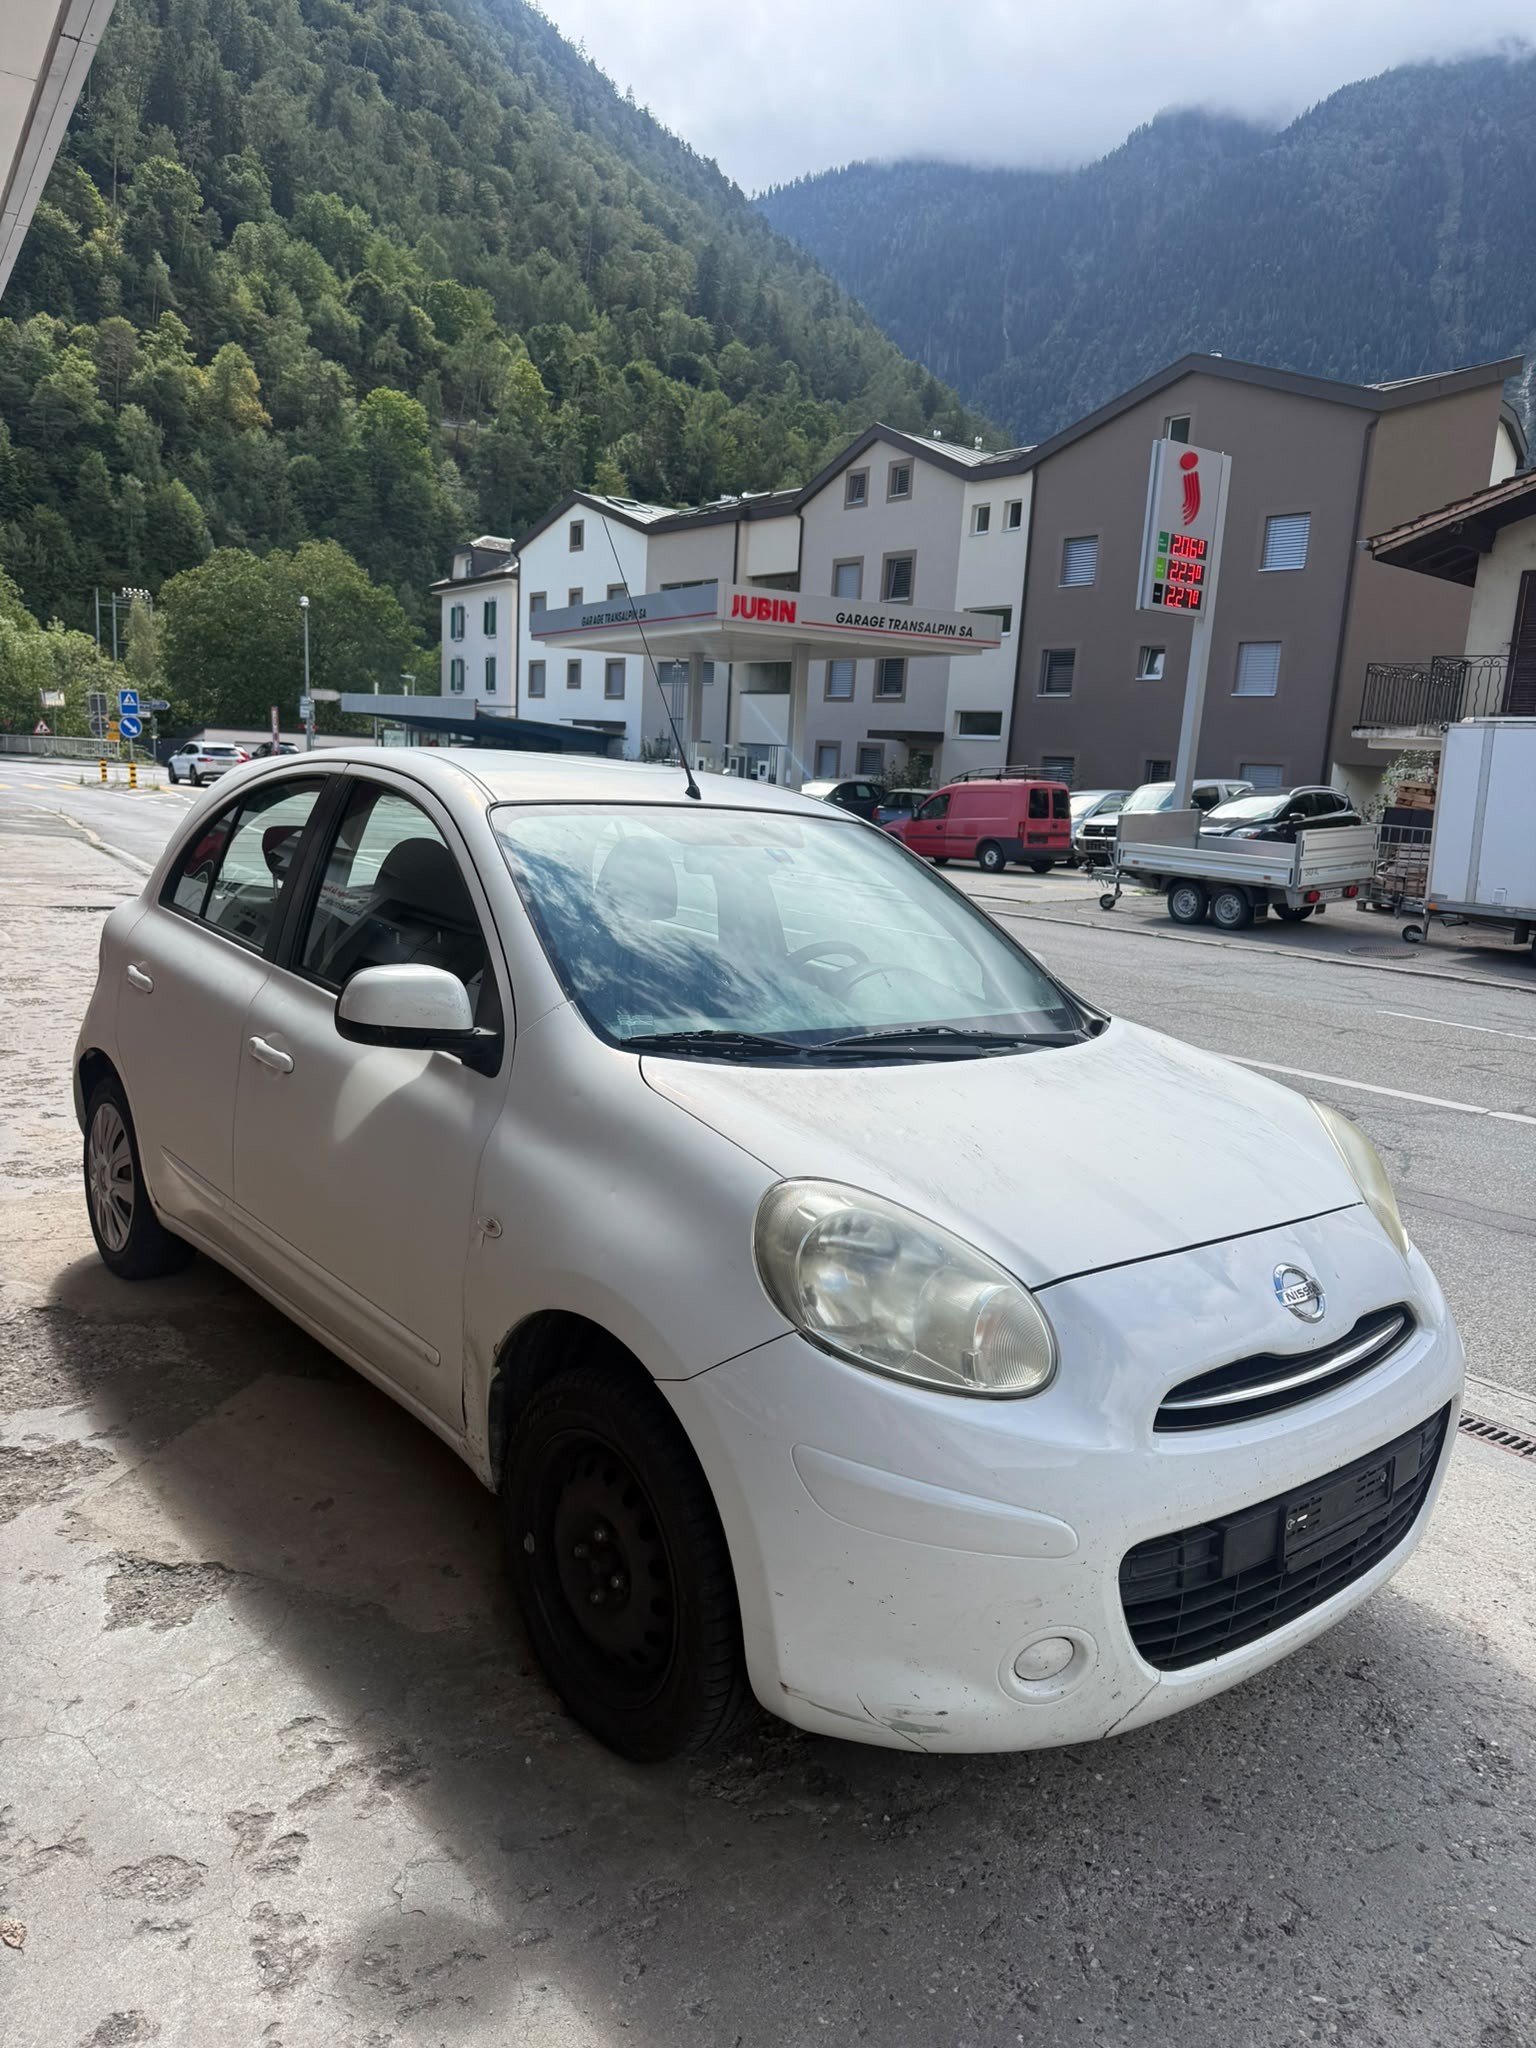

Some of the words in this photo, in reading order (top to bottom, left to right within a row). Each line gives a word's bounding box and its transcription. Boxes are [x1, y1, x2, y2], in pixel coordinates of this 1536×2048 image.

[581, 613, 604, 627] GARAGE
[639, 608, 647, 619] SA
[731, 594, 797, 623] JUBIN
[835, 612, 885, 628] GARAGE
[888, 618, 957, 636] TRANSALPIN
[958, 625, 973, 637] SA
